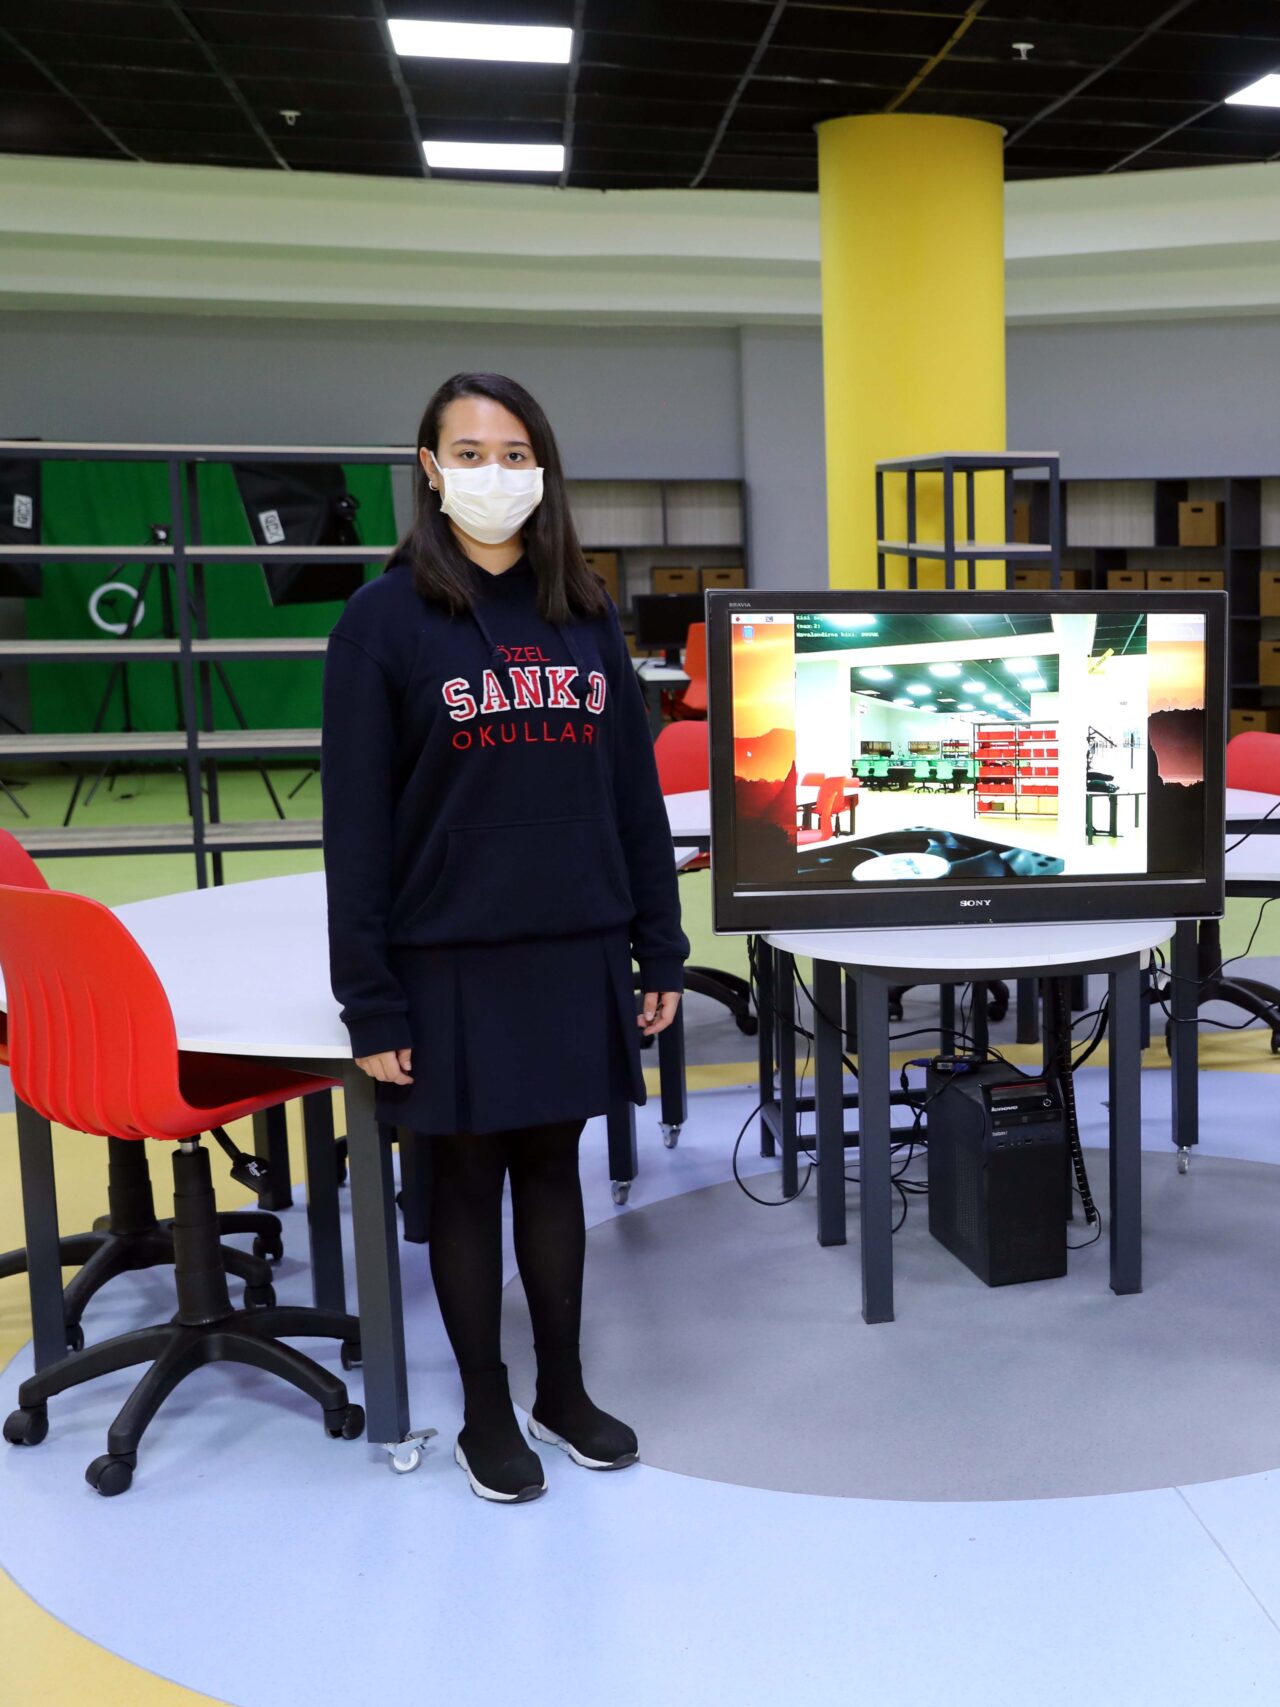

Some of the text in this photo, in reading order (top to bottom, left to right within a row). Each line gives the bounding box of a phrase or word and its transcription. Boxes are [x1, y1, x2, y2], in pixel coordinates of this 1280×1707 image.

[441, 666, 607, 722] SANKO
[452, 721, 596, 750] OKULLAR
[960, 899, 992, 907] SONY
